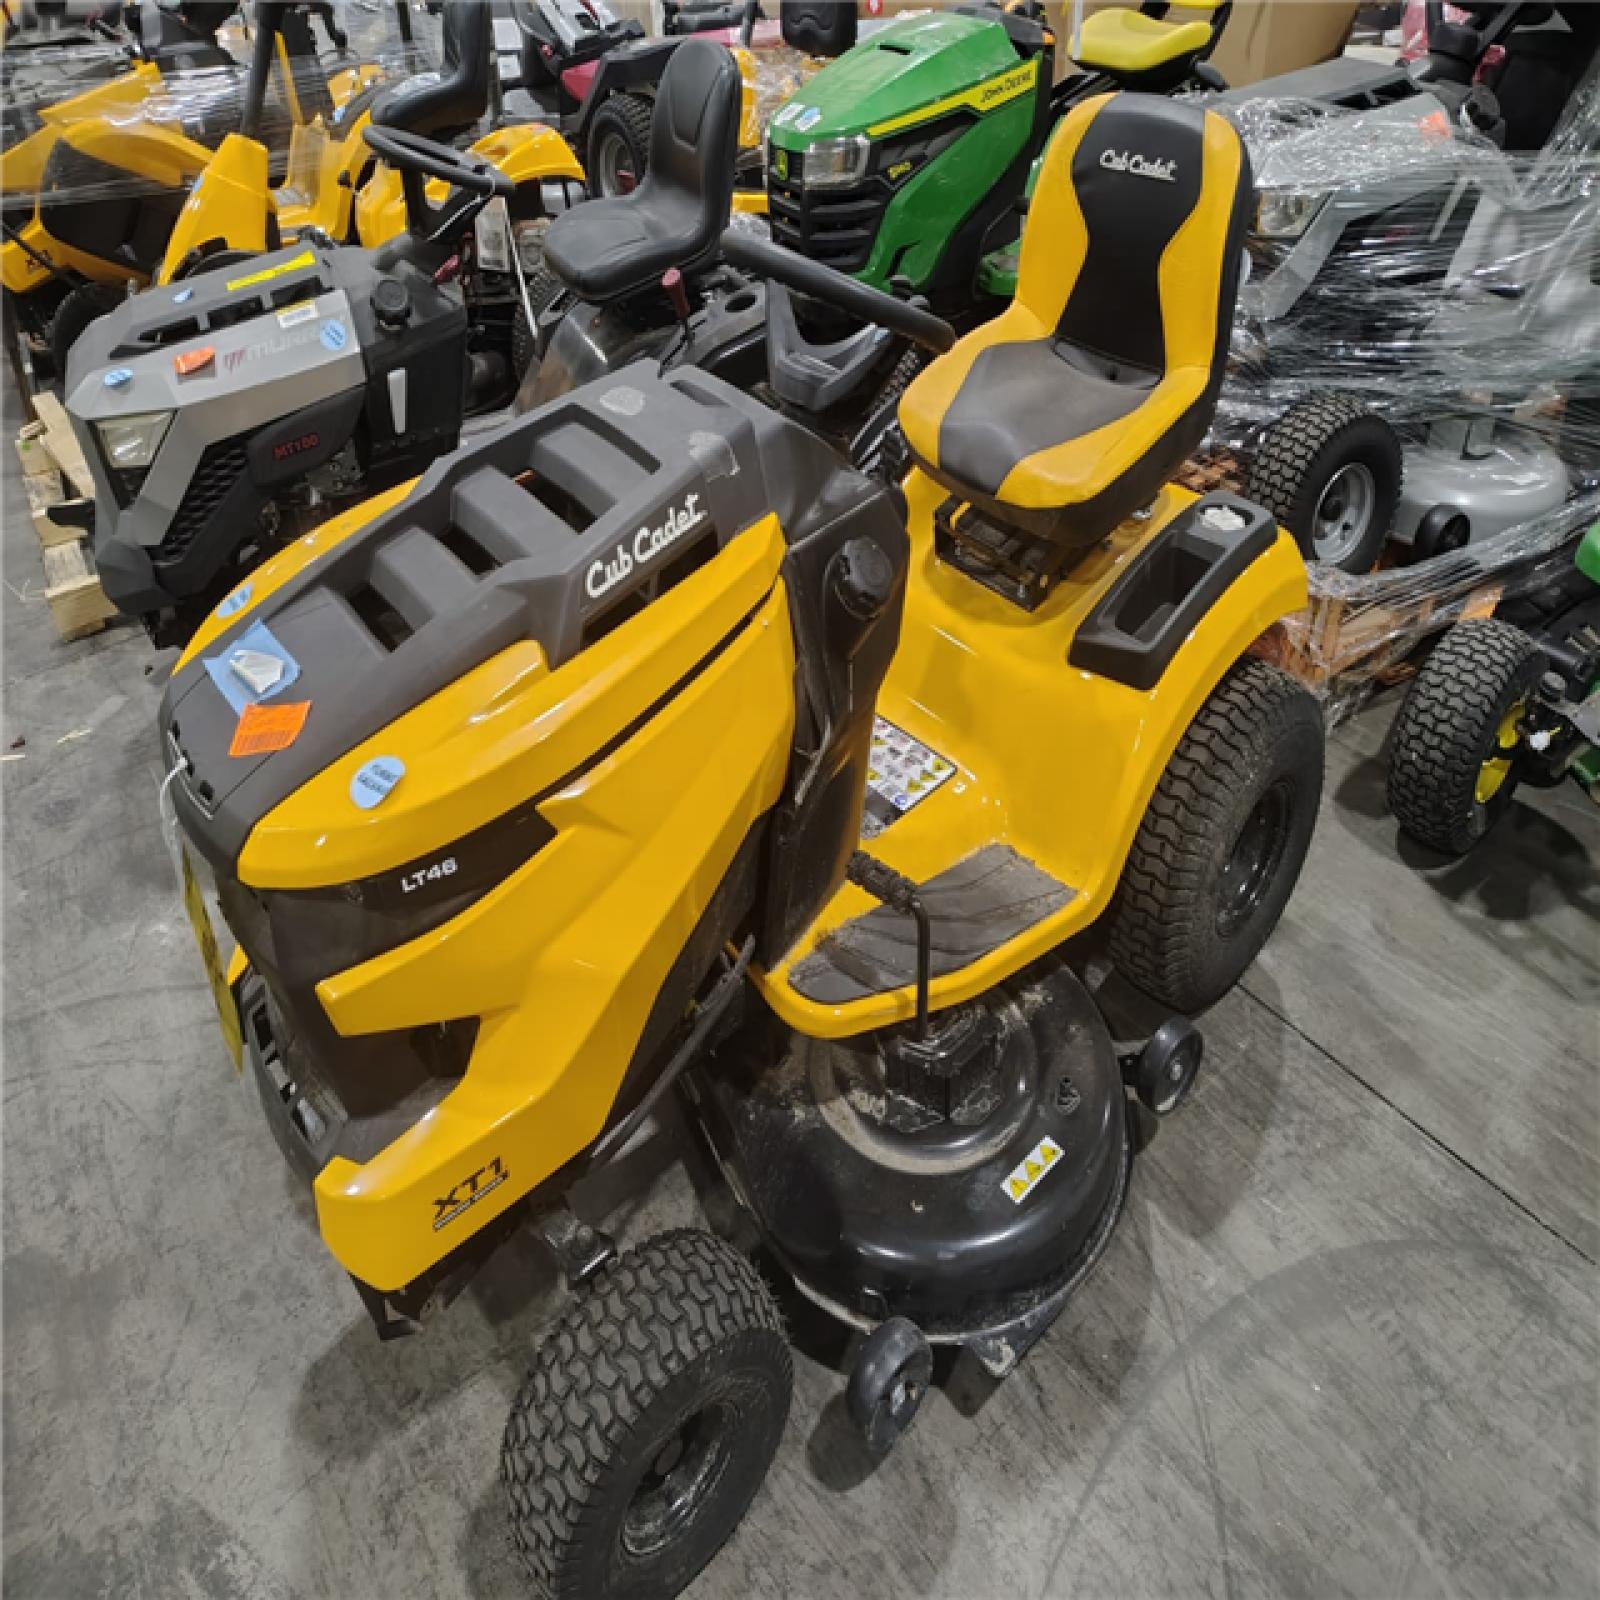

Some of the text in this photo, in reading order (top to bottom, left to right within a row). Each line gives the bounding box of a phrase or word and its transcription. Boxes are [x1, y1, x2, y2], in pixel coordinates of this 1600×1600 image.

[980, 68, 1031, 103] JOHN DEERE
[1099, 148, 1178, 181] Cub Cadet
[585, 492, 708, 598] Cub Cadet
[431, 1155, 502, 1220] XT1
